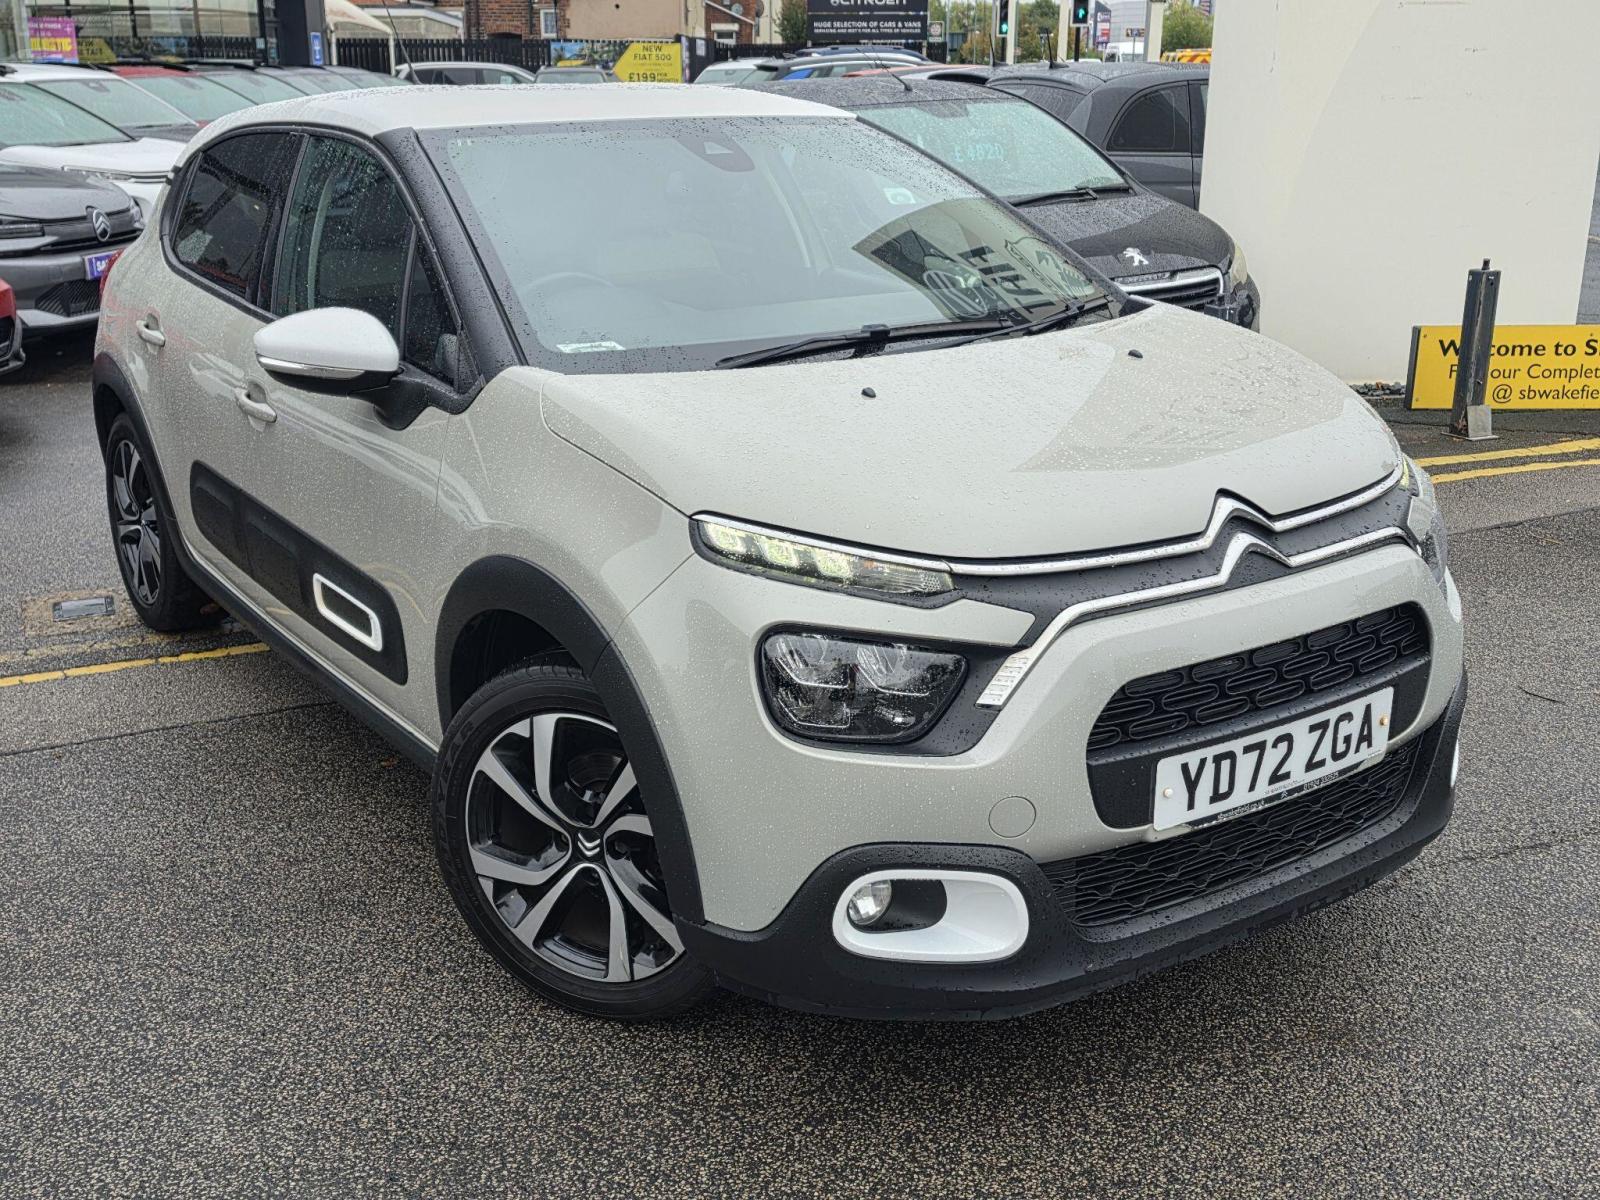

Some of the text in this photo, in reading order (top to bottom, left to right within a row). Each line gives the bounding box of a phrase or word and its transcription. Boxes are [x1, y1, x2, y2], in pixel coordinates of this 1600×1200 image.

[642, 45, 663, 53] NEW
[629, 72, 656, 82] £199
[1438, 339, 1546, 357] Wcome
[1554, 341, 1577, 356] to
[1492, 384, 1513, 404] @
[1181, 703, 1373, 811] YD72 ZGA
